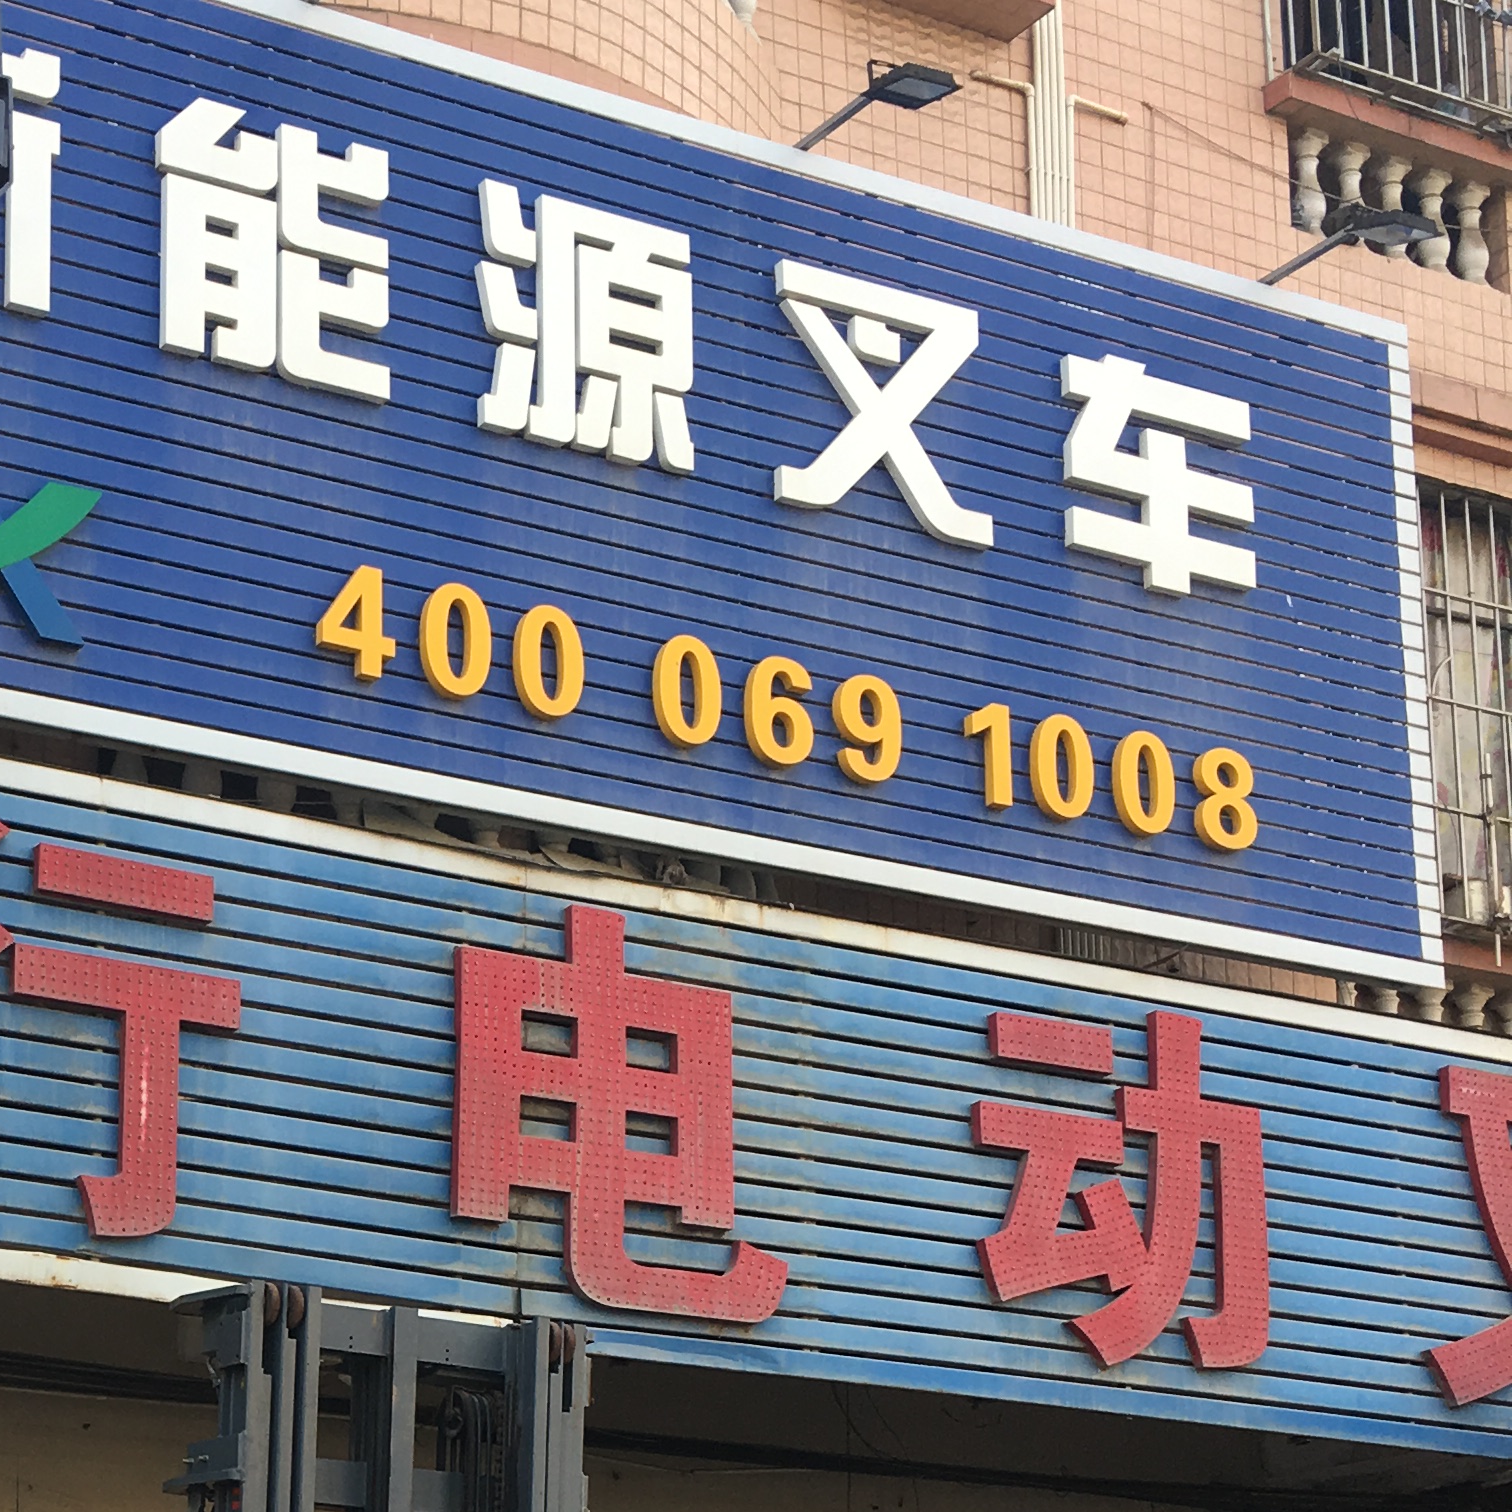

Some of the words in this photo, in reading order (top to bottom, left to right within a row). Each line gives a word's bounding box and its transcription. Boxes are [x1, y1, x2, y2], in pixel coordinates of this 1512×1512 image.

[316, 564, 585, 720] 400
[652, 633, 903, 787] 069
[964, 701, 1259, 854] 1008
